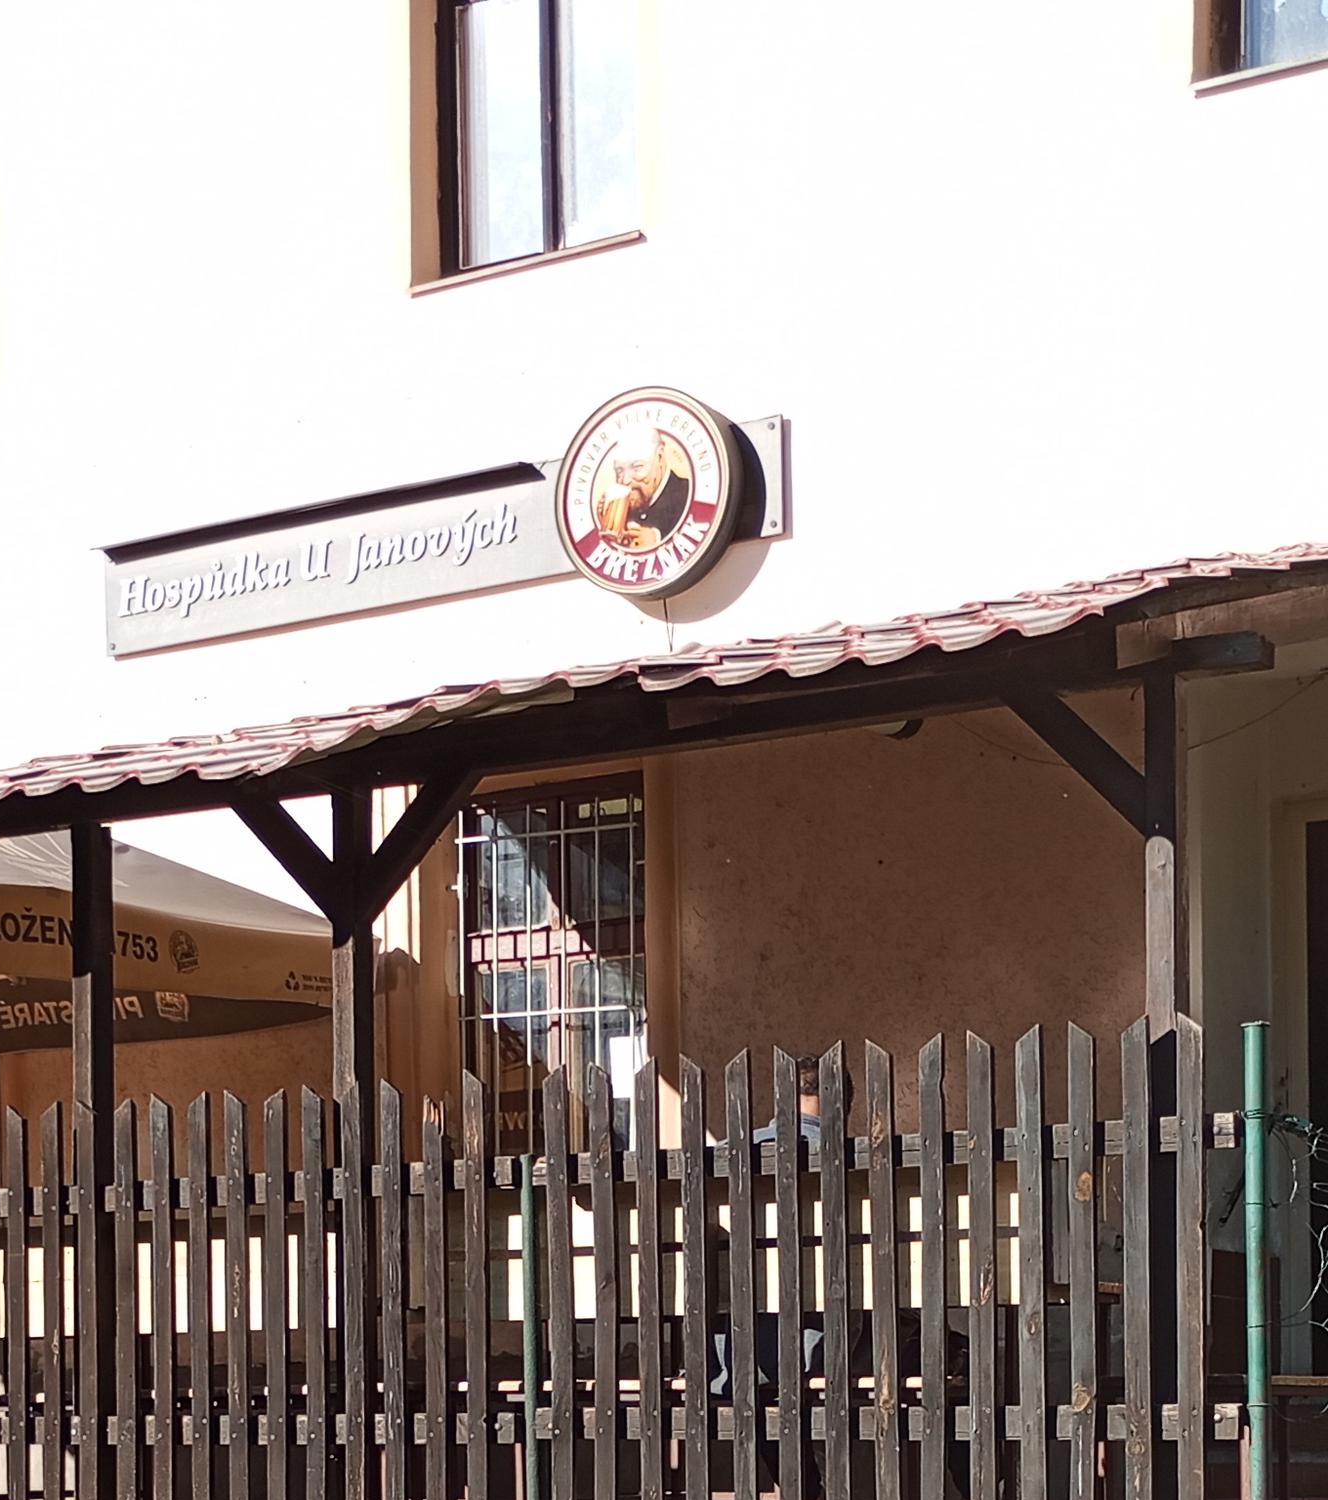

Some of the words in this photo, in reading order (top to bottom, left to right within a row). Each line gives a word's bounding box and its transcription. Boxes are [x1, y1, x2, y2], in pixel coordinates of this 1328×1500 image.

[118, 550, 292, 618] Hospůdka
[299, 535, 333, 582] U
[344, 504, 518, 583] Janových
[112, 930, 159, 963] 753
